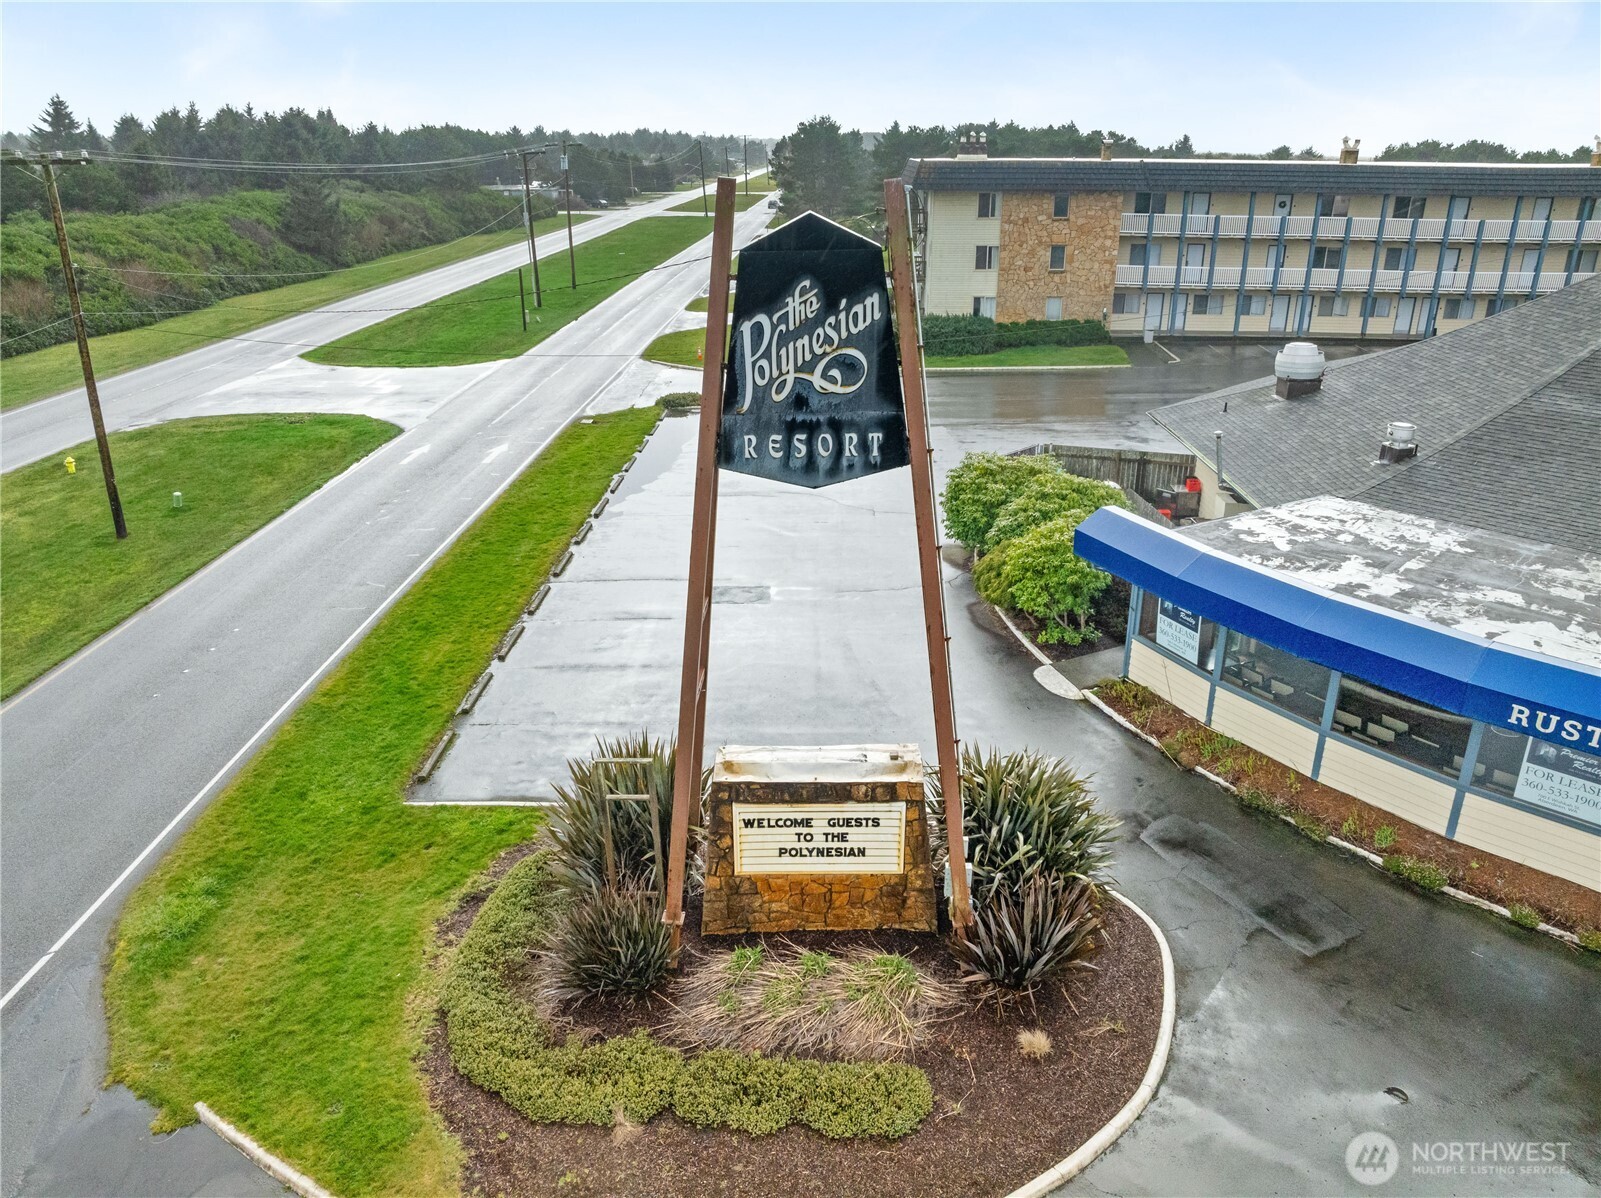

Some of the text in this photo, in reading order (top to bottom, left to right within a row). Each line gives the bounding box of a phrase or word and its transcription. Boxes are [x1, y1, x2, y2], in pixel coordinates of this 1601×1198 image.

[773, 279, 821, 331] the
[736, 292, 882, 414] Polynesian
[744, 432, 883, 459] RESORT
[1159, 616, 1174, 630] FOR
[1174, 624, 1197, 642] LEASE
[1507, 703, 1601, 748] RUST
[1560, 748, 1599, 765] Premier
[1525, 765, 1555, 783] FOR
[1521, 777, 1601, 810] 360-533-1900
[742, 817, 880, 828] WELCOME GUESTS
[795, 832, 849, 843] TO THE
[778, 847, 866, 858] POLYNESIAN
